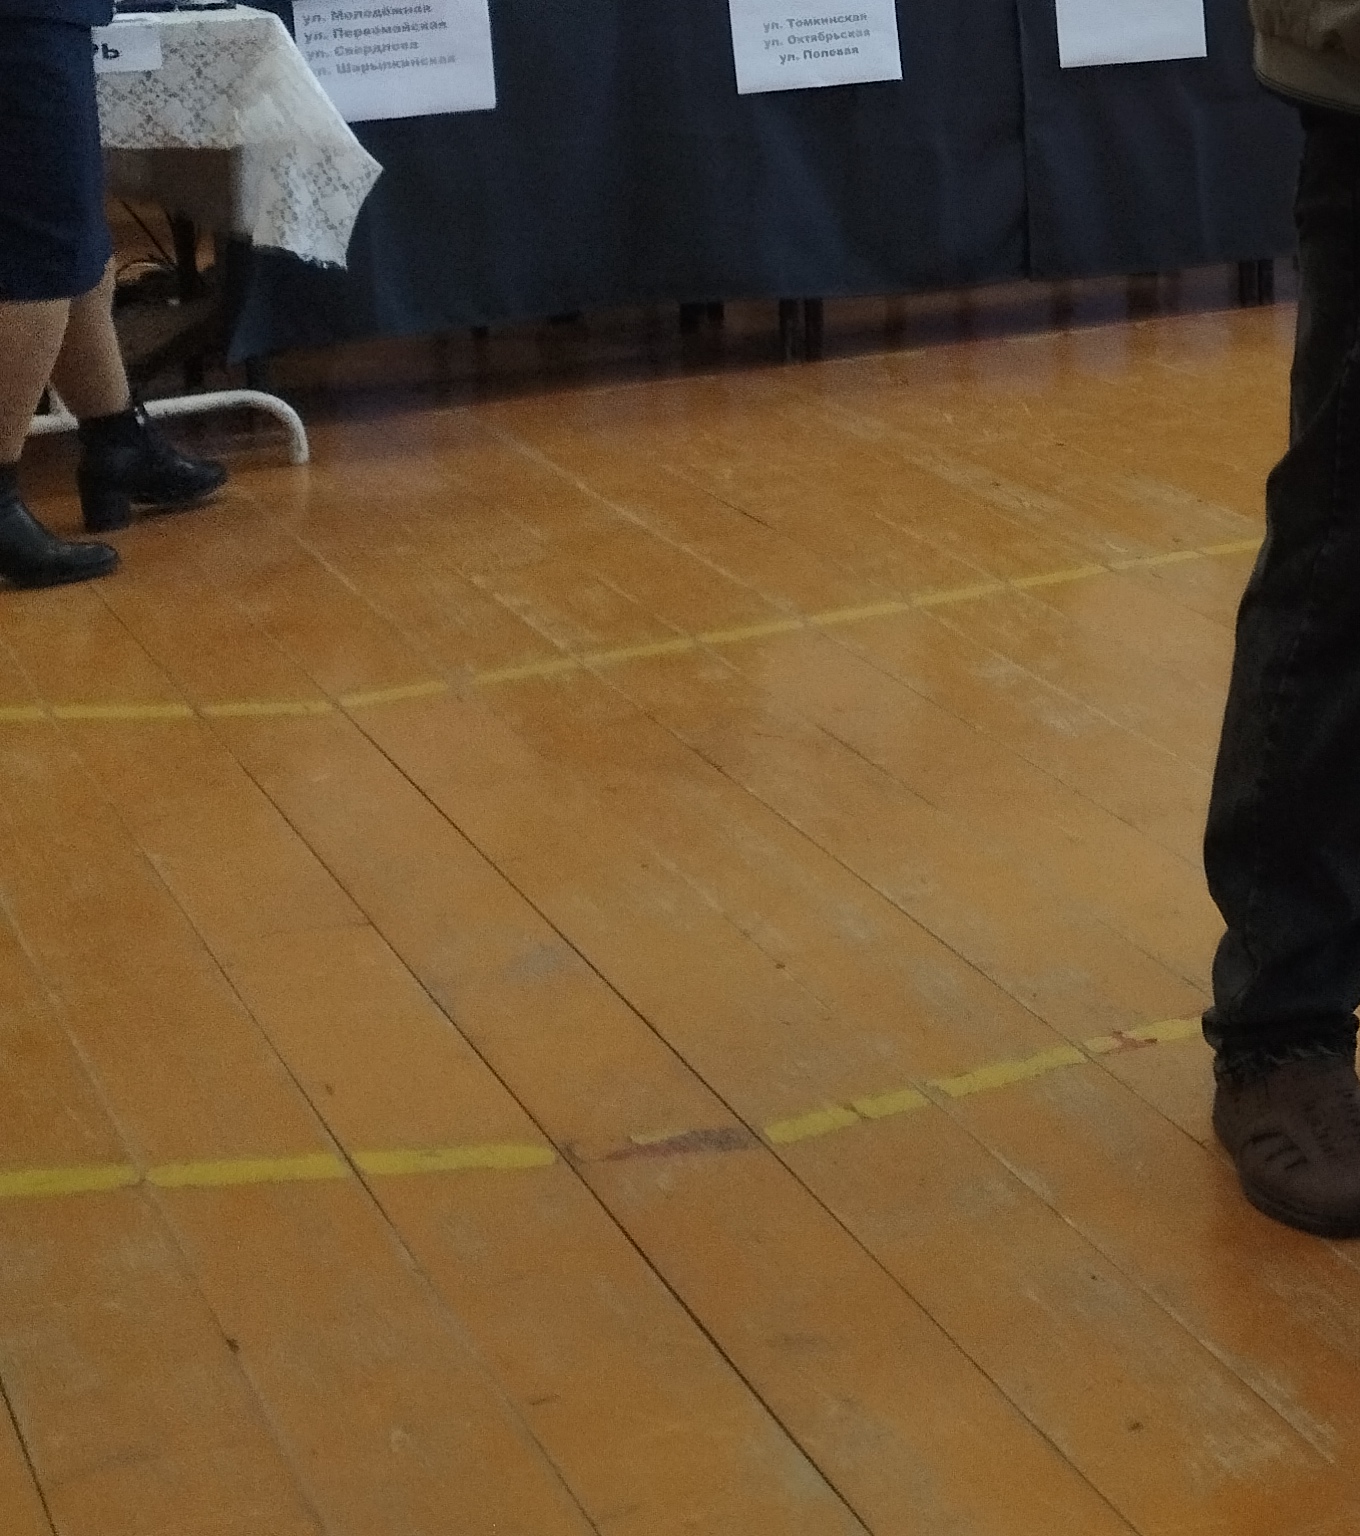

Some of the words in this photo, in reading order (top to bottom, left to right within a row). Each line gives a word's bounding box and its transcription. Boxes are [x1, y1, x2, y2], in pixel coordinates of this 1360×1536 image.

[764, 22, 783, 33] ул.
[764, 39, 783, 49] ул.
[787, 29, 871, 45] Октябрьская
[779, 53, 800, 65] ул.
[803, 46, 859, 60] Полевая
